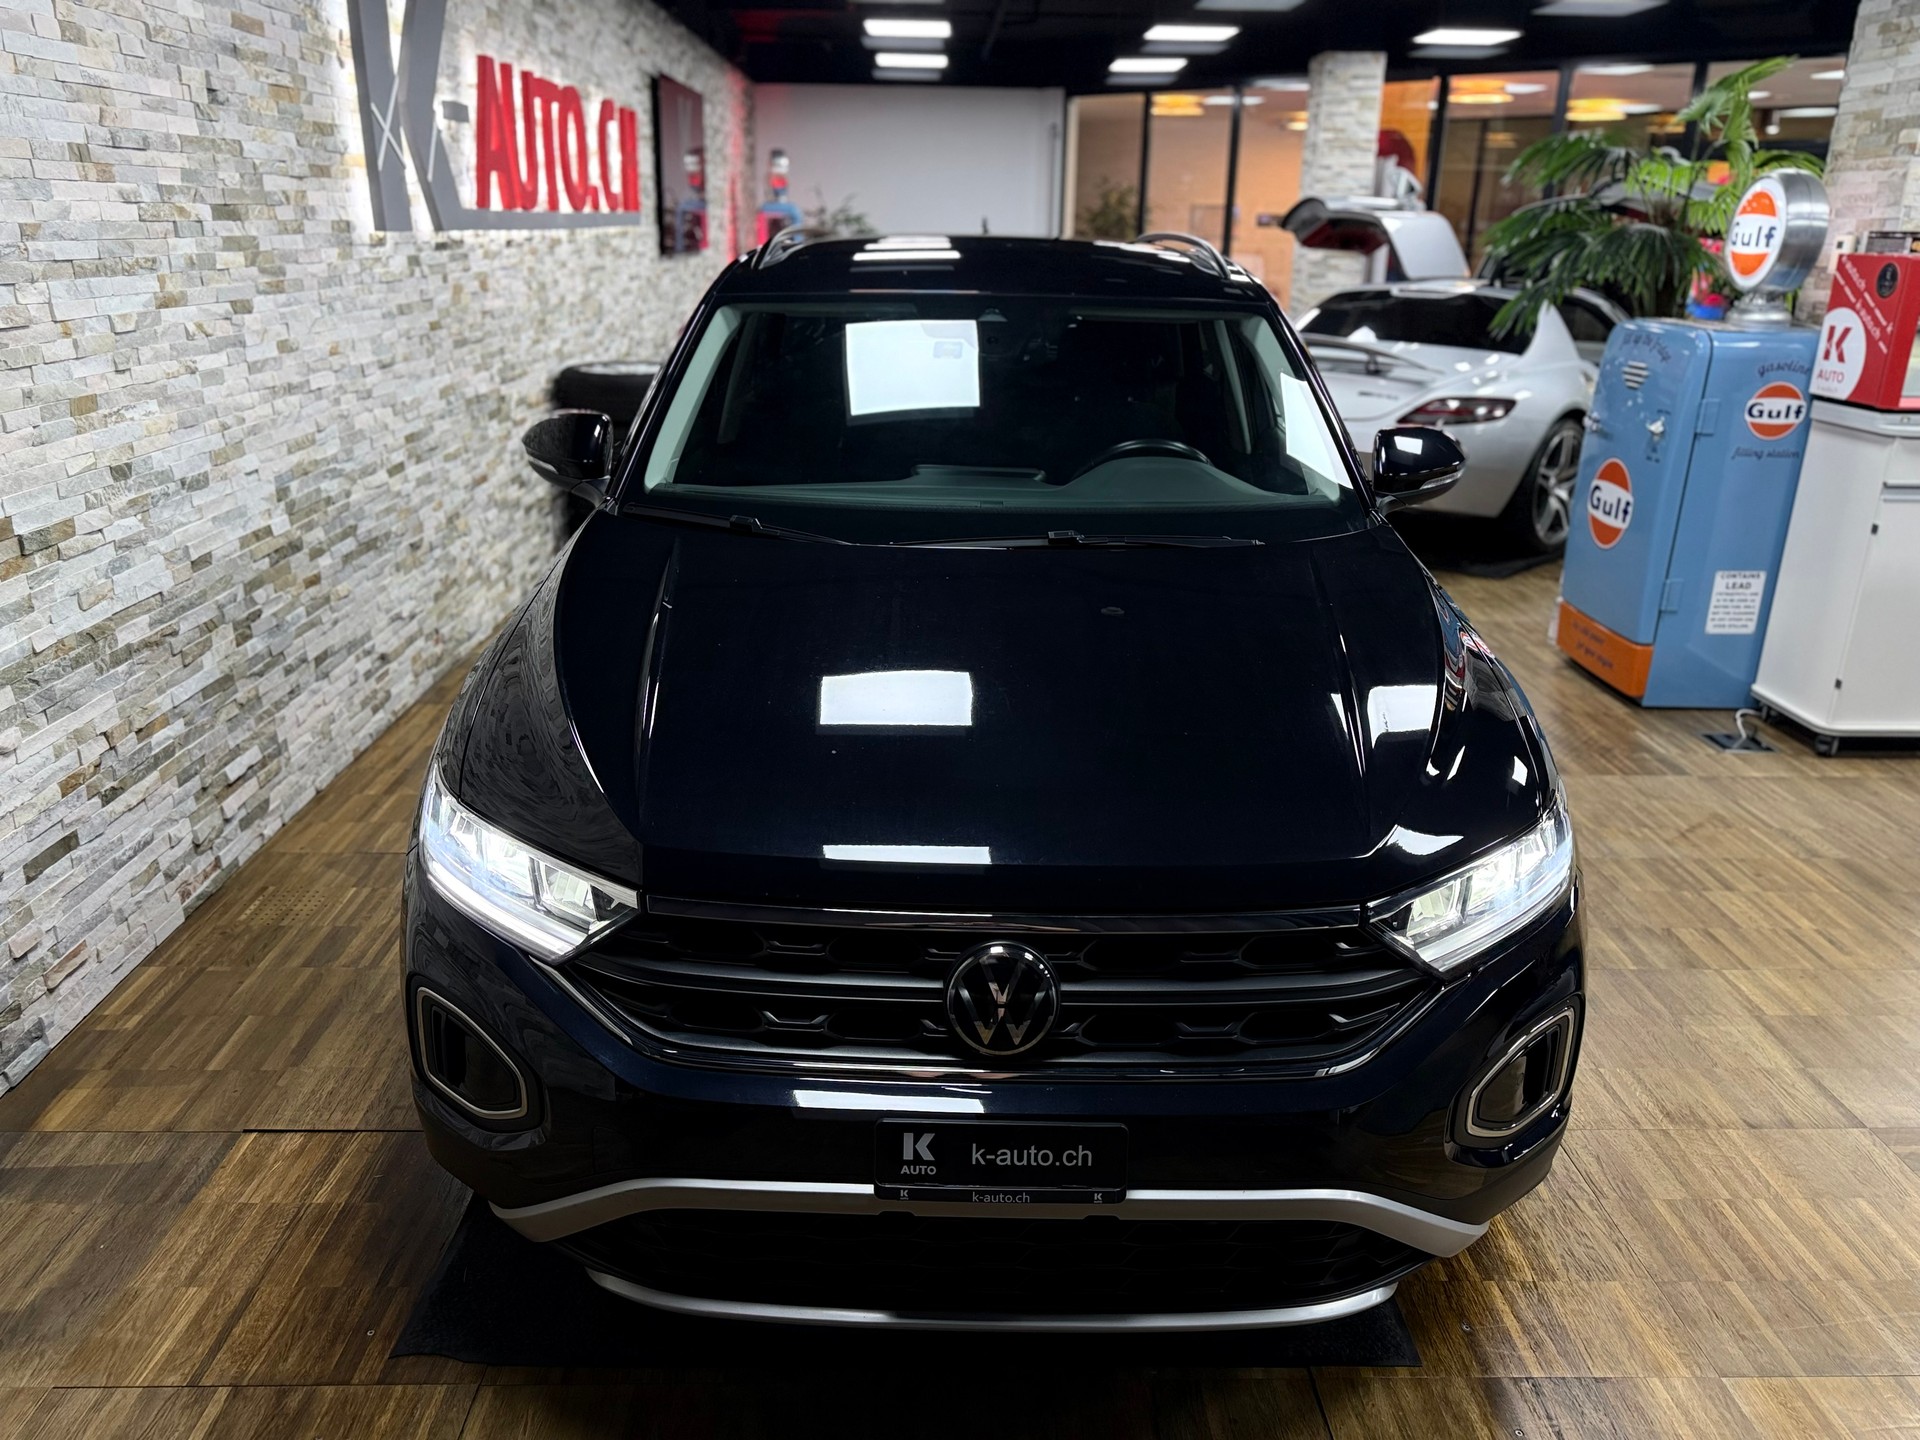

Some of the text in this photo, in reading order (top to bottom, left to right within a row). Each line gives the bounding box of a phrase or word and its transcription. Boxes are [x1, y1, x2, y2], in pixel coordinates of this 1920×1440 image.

[1731, 221, 1777, 248] Gulf
[1823, 325, 1852, 363] K
[1816, 369, 1845, 384] AUTO
[1747, 402, 1804, 419] Gulf
[1590, 485, 1631, 523] Gulf
[1725, 582, 1752, 590] LEAD
[903, 1133, 936, 1161] K
[971, 1143, 1093, 1167] k-auto.ch
[900, 1165, 937, 1175] AUTO
[972, 1191, 1030, 1203] k-auto.ch
